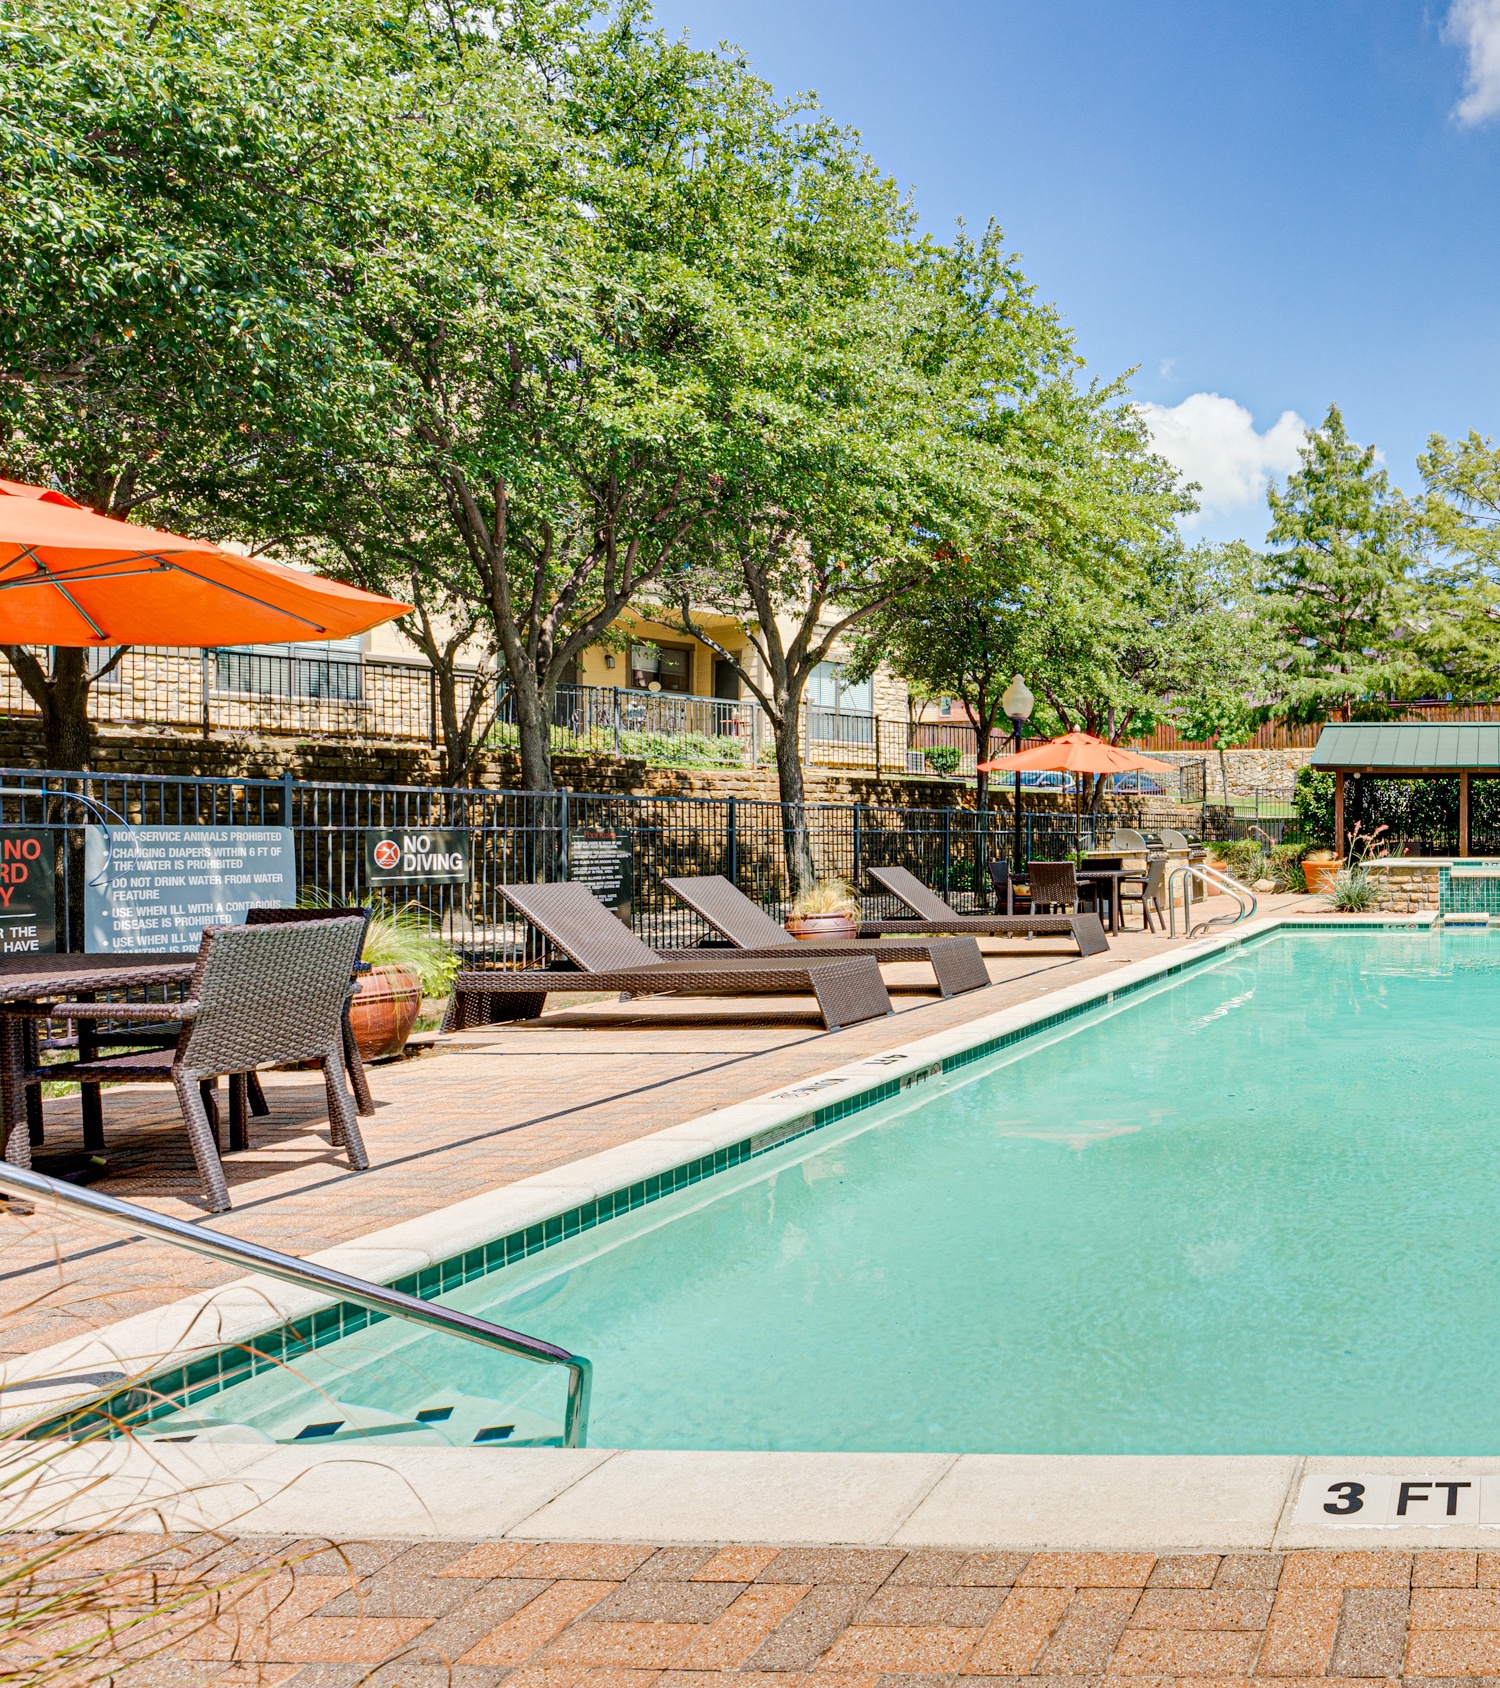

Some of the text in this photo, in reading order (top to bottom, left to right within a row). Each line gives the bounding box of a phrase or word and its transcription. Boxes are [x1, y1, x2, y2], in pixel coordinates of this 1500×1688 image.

[113, 831, 282, 842] NON-SERVICE ANIMALS PROHIBITED
[4, 839, 41, 860] NO
[403, 835, 431, 853] NO
[112, 847, 282, 858] CHANGING DIAPERS WITHIN 6 FT OF
[113, 859, 243, 871] THE WATER IS PROHIBITED
[403, 852, 463, 872] DIVING
[112, 874, 284, 888] DO NOT DRINK WATER FROM WATER
[113, 889, 160, 901] FEATURE
[112, 900, 281, 918] USE WHEN ILL WITH A CONTAGIOUS
[113, 915, 232, 931] DISEASE IS PROHIBITED
[10, 926, 37, 938] THE
[4, 940, 39, 953] HAVE
[112, 937, 134, 948] USE
[137, 935, 168, 946] WHEN
[171, 934, 187, 944] ILL
[1323, 1481, 1366, 1515] 3
[1396, 1482, 1472, 1516] FT
